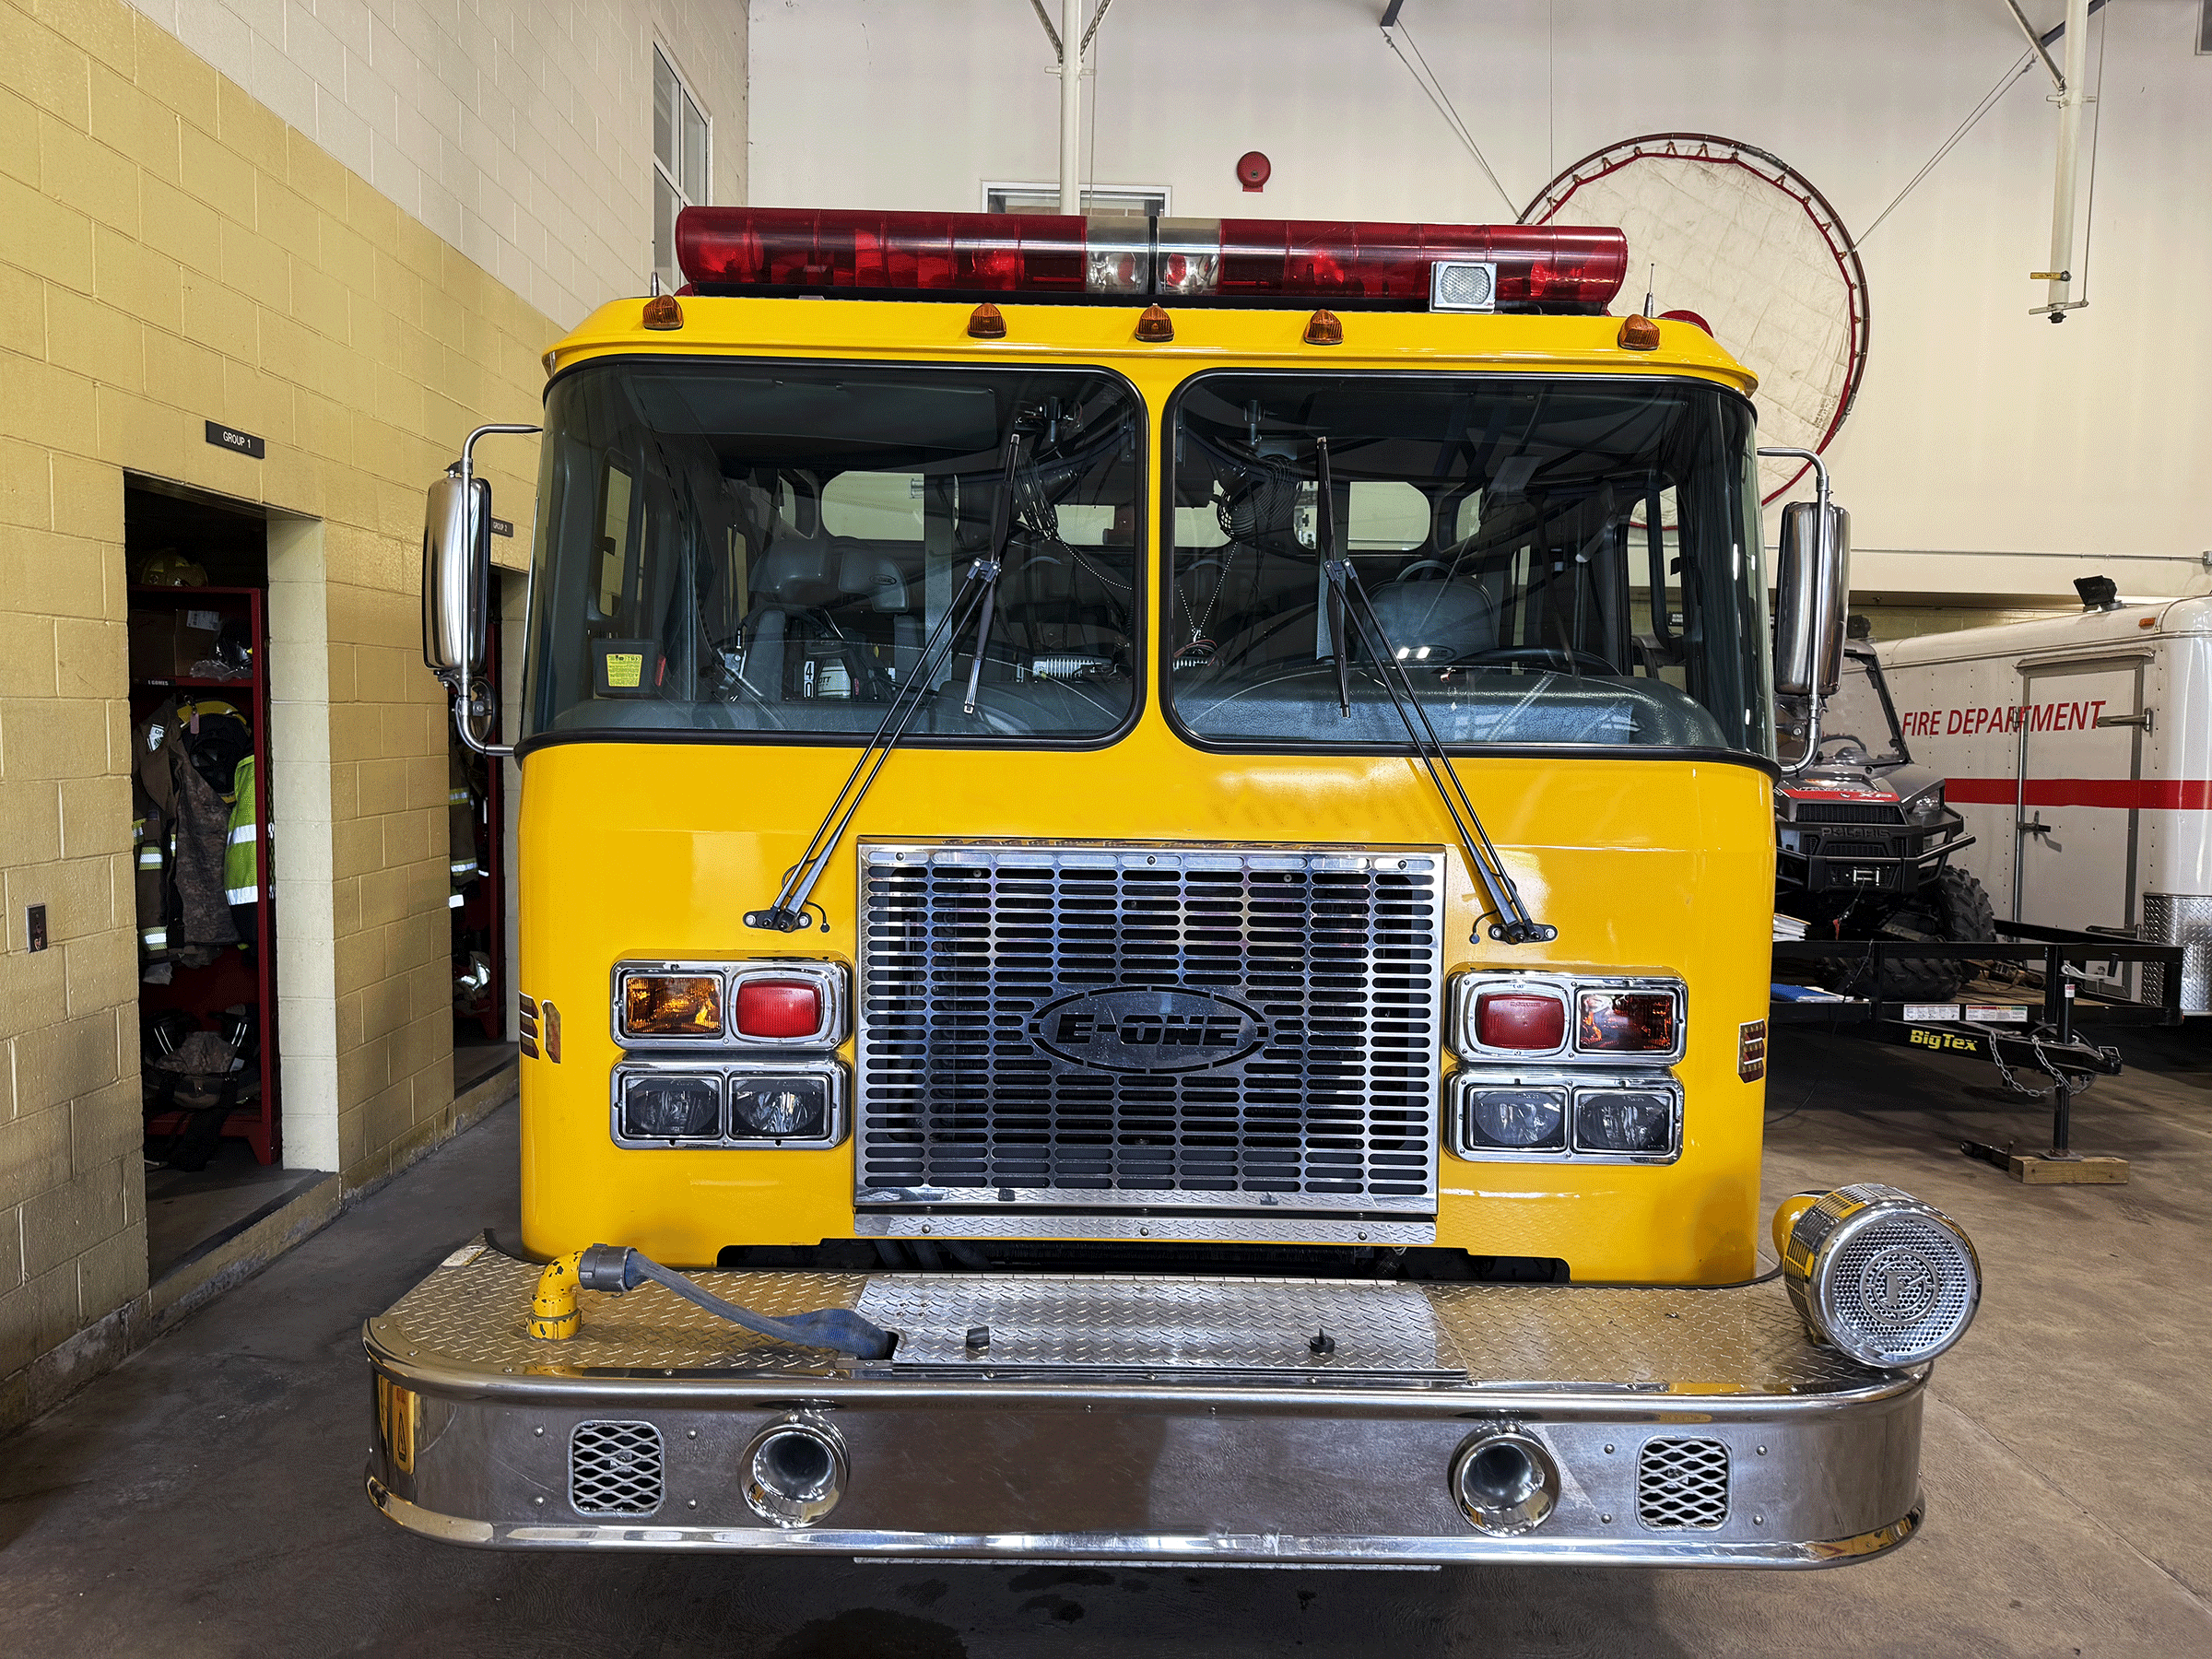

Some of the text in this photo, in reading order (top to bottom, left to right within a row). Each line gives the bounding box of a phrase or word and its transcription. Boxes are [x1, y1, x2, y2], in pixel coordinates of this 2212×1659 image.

[223, 430, 252, 449] GROUP 1
[1902, 700, 2106, 736] FIRE DEPARTMENT
[1820, 827, 1890, 839] POLARIS
[1055, 1014, 1242, 1047] E-ONE
